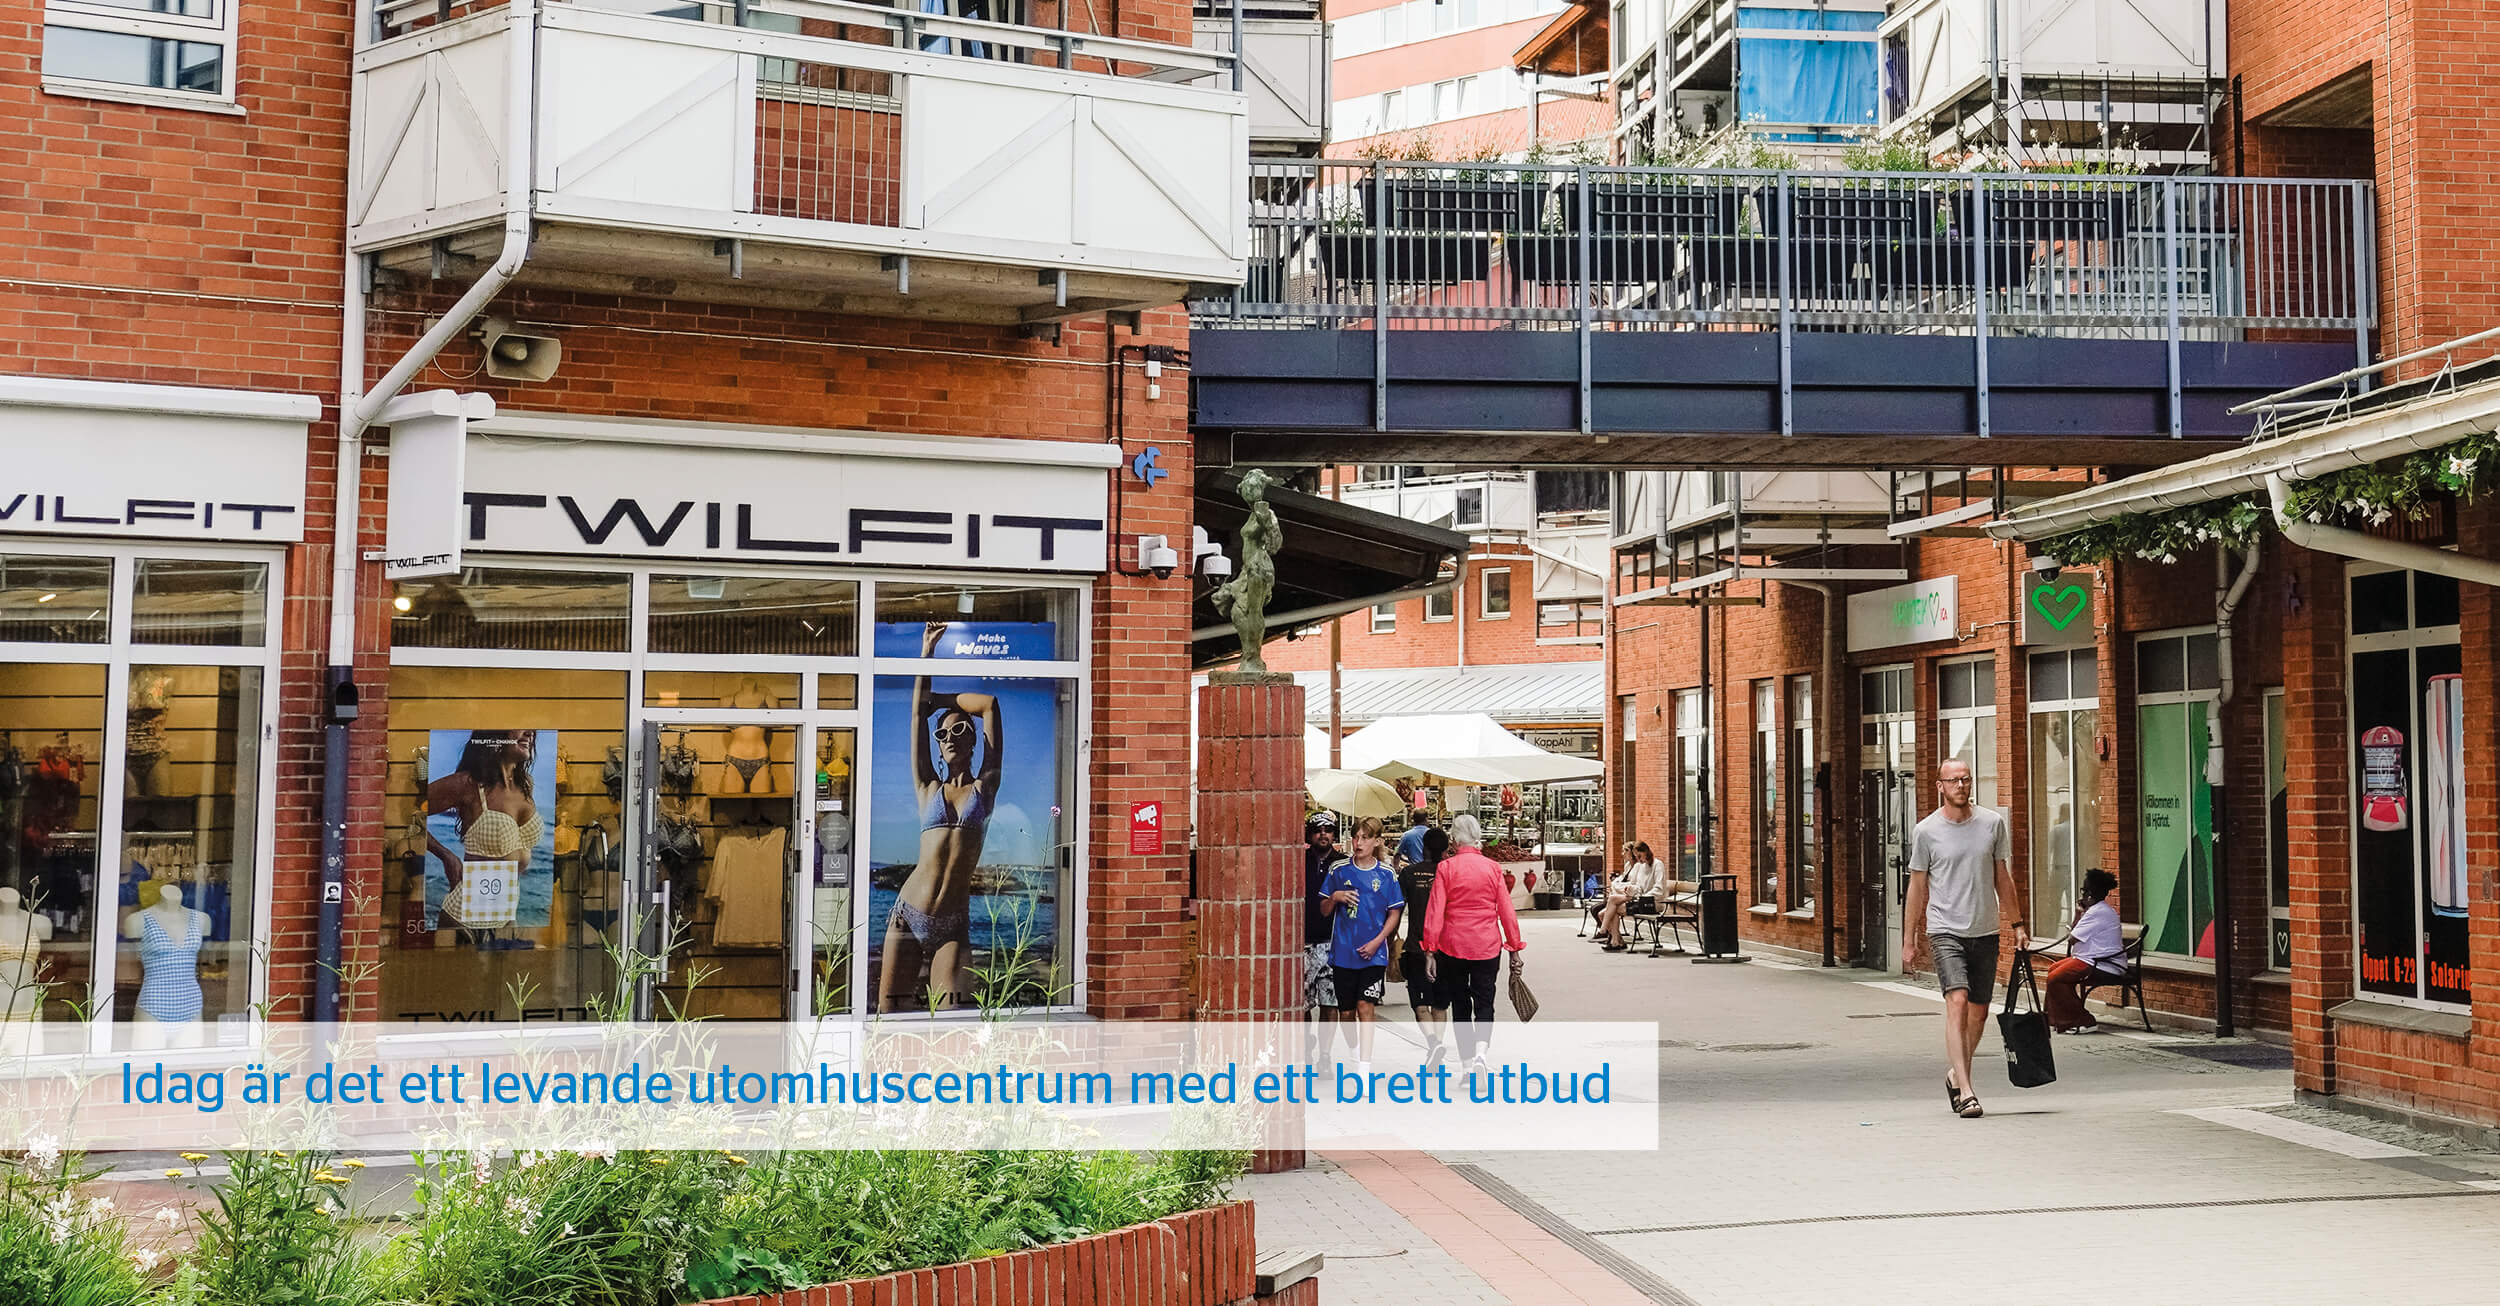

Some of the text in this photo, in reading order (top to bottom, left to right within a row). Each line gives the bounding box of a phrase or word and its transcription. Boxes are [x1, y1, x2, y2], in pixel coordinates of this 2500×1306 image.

[463, 491, 1103, 561] TWILFIT
[385, 554, 452, 569] TWILFIT
[977, 634, 1006, 643] Make
[954, 642, 1009, 655] Waves
[1534, 737, 1572, 749] KappAhl
[479, 878, 502, 896] 30
